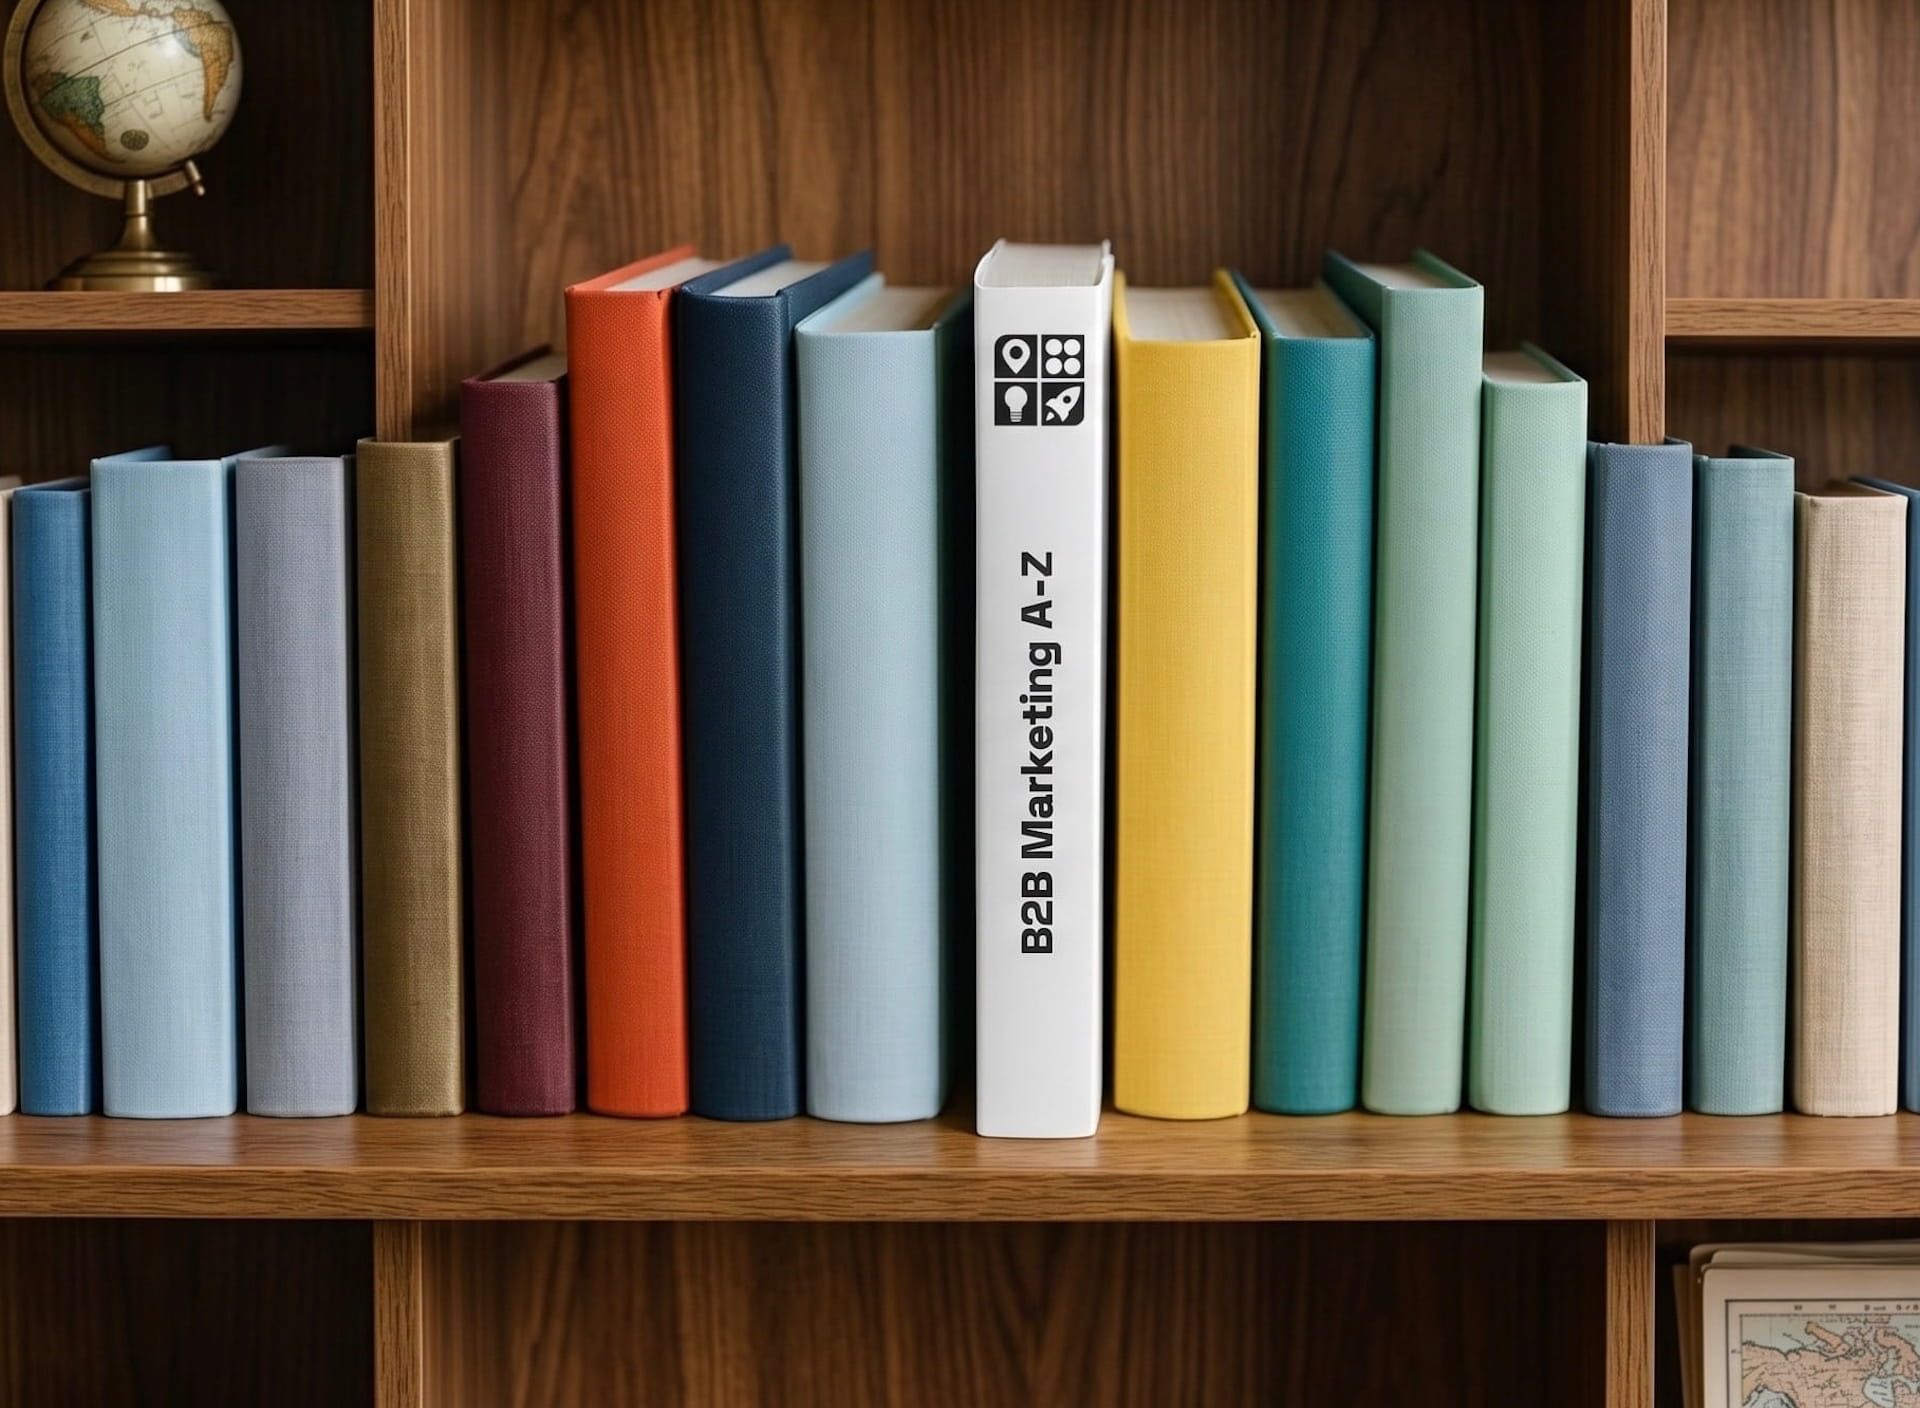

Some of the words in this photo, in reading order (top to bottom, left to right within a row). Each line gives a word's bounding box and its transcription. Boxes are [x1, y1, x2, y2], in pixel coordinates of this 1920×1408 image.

[1020, 551, 1053, 630] A-Z
[1019, 642, 1062, 859] Marketing
[1020, 871, 1053, 954] B2B
